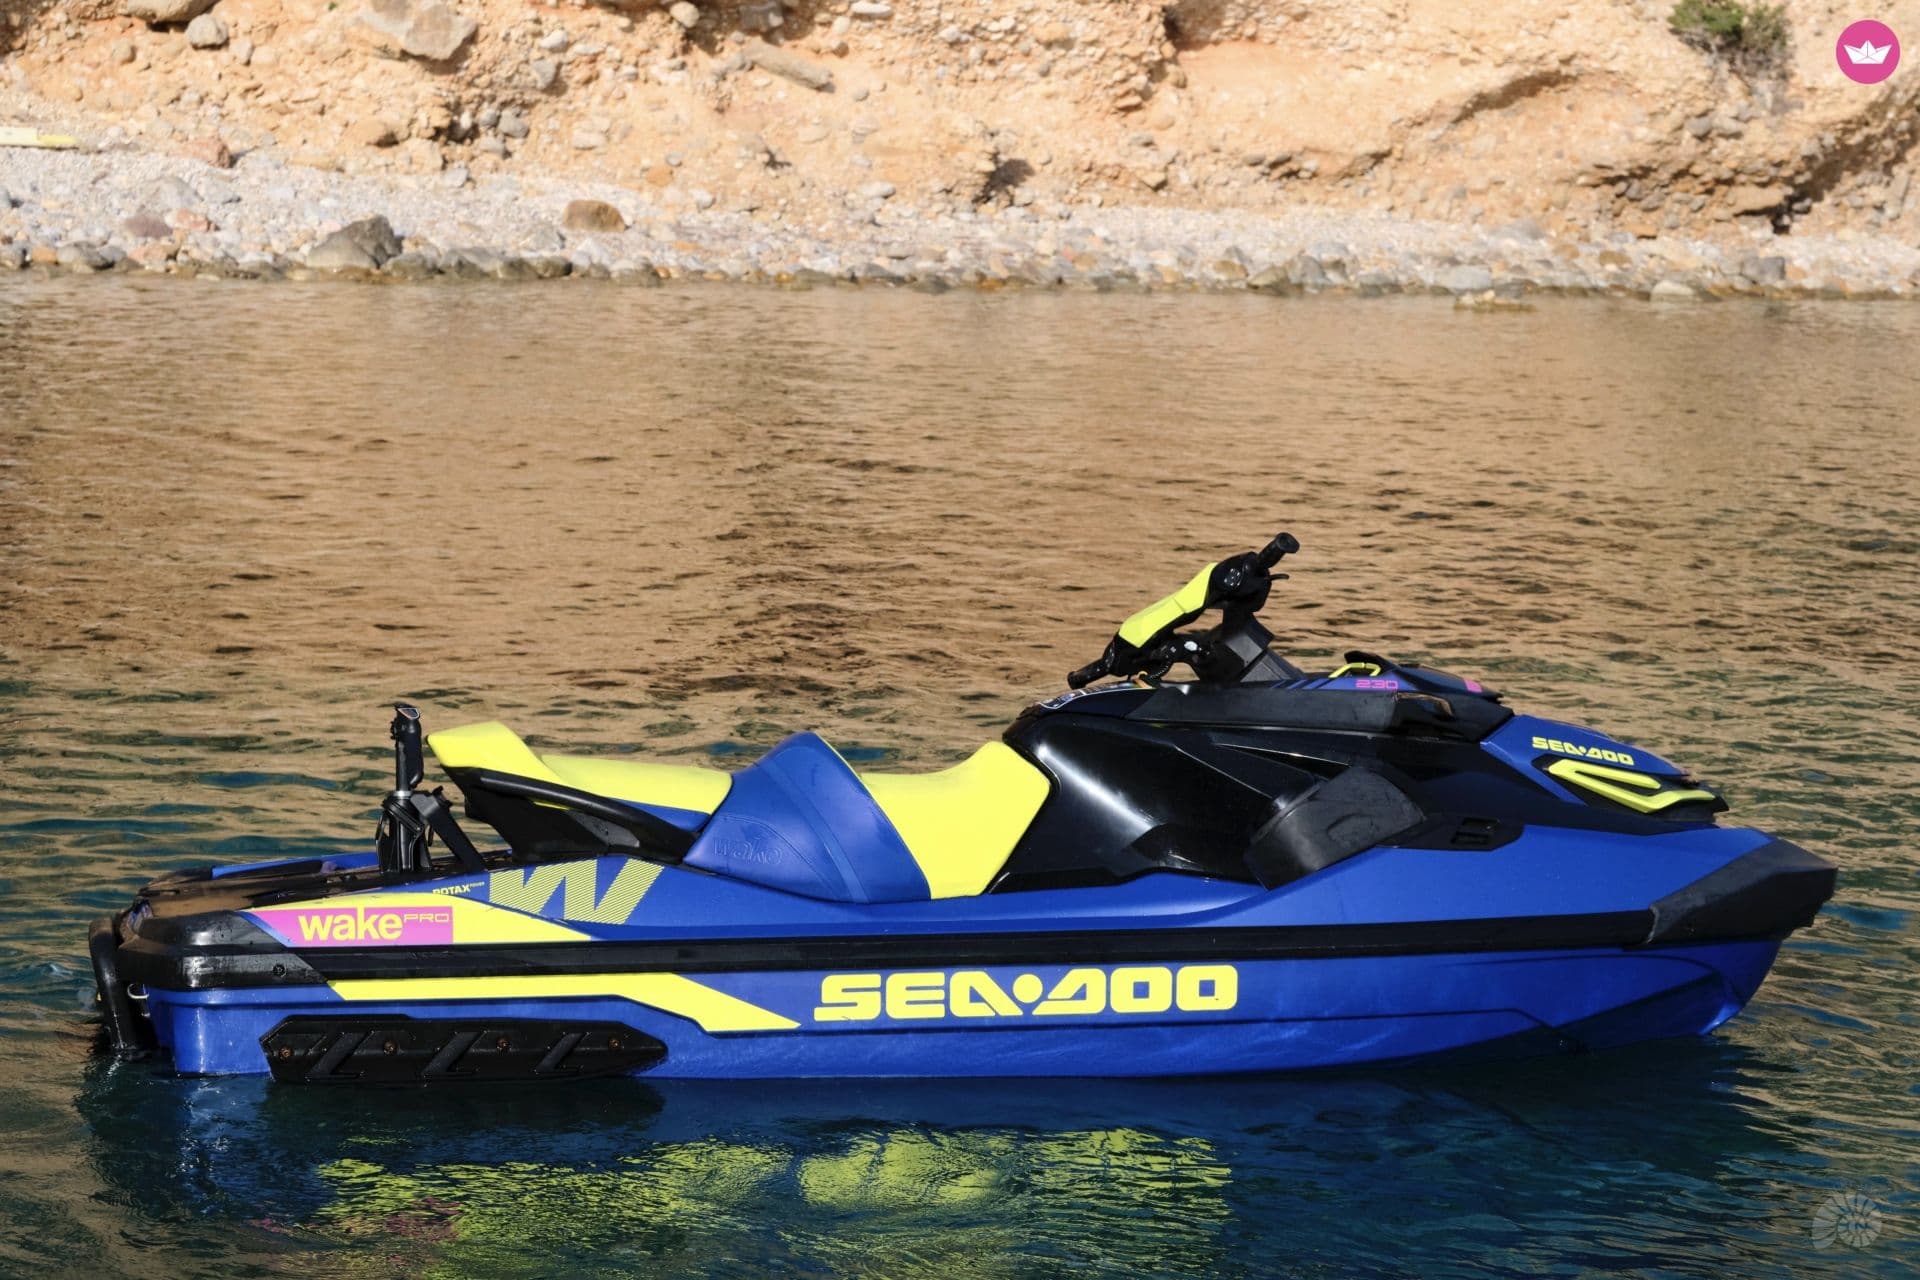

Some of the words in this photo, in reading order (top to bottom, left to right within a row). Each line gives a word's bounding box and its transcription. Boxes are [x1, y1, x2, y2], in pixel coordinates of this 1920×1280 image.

[1356, 679, 1398, 690] 230
[298, 907, 403, 942] wake
[404, 913, 449, 923] PRO
